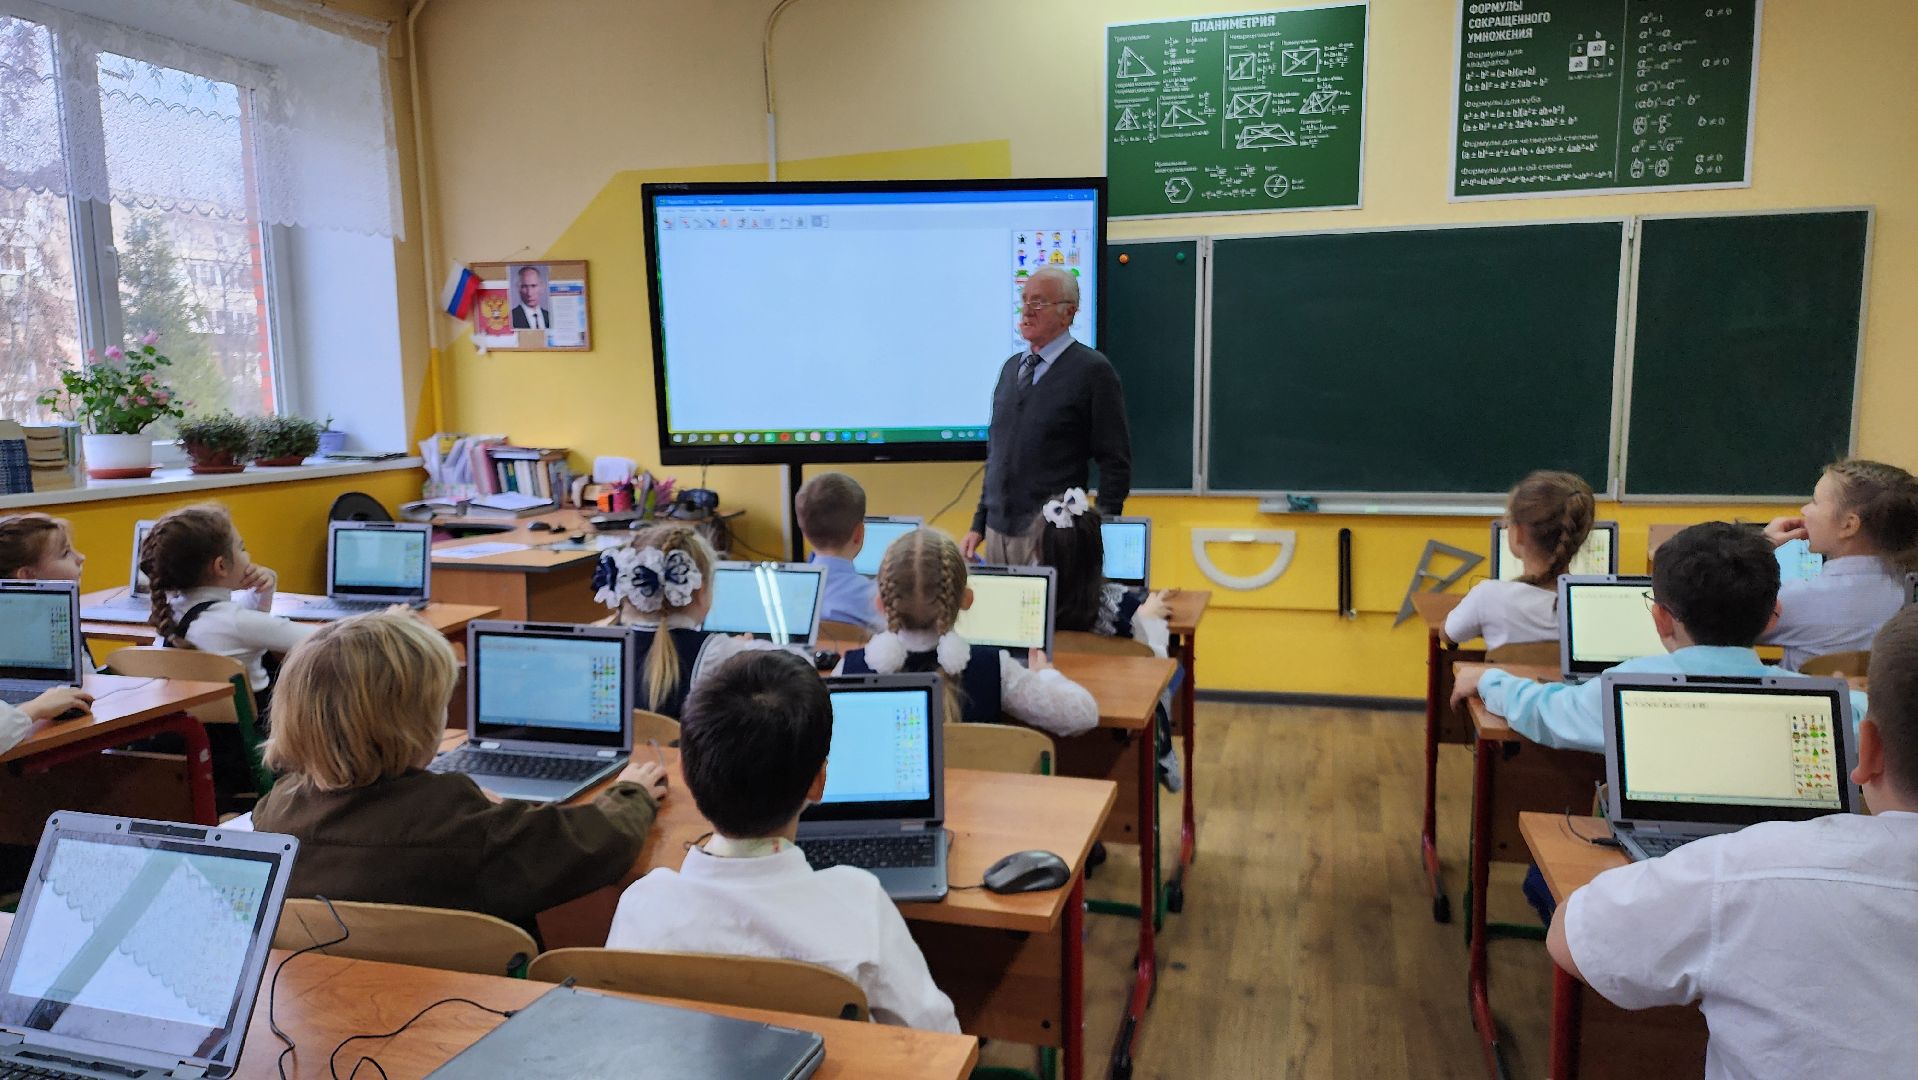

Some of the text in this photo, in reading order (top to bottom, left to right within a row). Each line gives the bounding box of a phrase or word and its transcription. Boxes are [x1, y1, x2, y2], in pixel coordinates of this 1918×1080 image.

[1469, 0, 1523, 14] ФОРМУЛЫ
[1191, 15, 1276, 33] ПЛАНИМЕТРИЯ
[1468, 12, 1551, 29] СОКРАЩЕННОГО
[1467, 28, 1533, 43] УМНОЖЕНИЯ
[1595, 30, 1602, 39] b
[1522, 96, 1541, 104] куба
